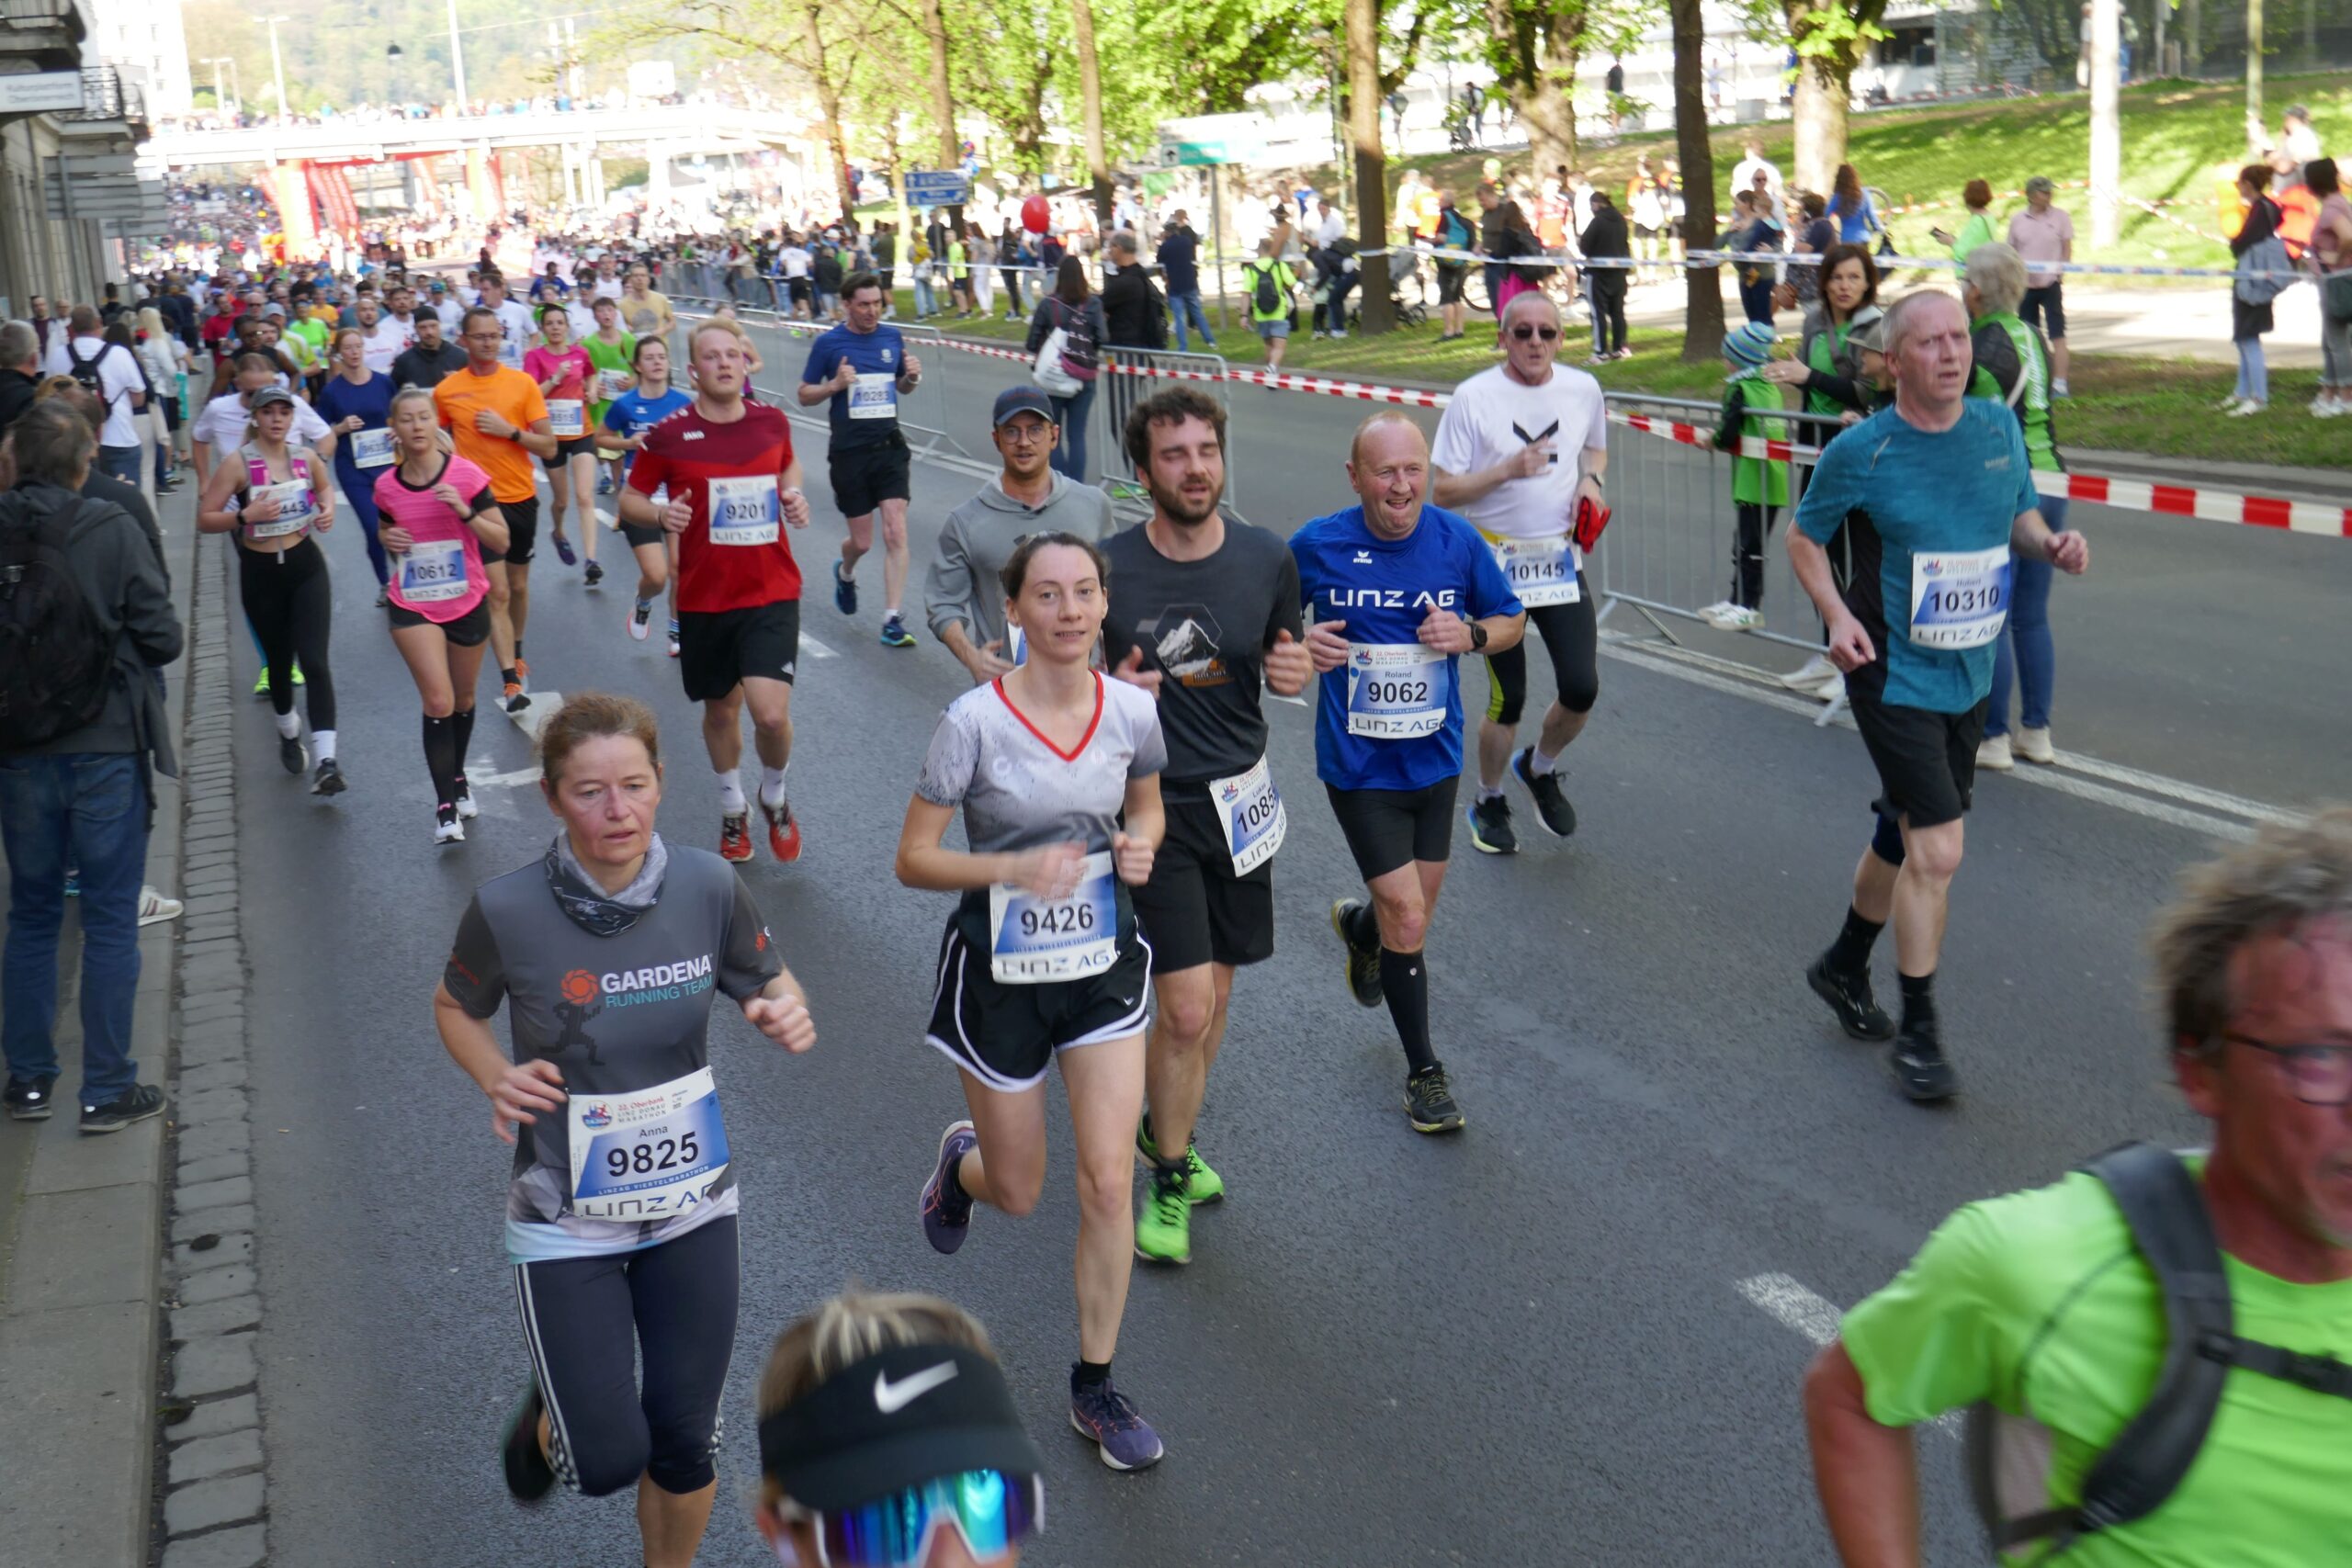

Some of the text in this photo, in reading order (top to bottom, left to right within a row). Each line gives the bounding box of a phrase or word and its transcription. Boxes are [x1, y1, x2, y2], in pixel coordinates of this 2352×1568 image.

[279, 500, 306, 514] 443
[726, 502, 766, 521] 9201
[409, 563, 458, 581] 10612
[1509, 561, 1565, 581] 10145
[1329, 589, 1455, 608] LINZ AG
[1929, 584, 2000, 614] 10310
[1385, 671, 1412, 679] Roland
[1367, 682, 1428, 704] 9062
[1355, 716, 1440, 733] LINZ AG
[1020, 903, 1094, 937] 9426
[600, 954, 712, 993] GARDENA
[1002, 949, 1111, 977] LINZ AG
[605, 975, 713, 1009] RUNNING TEAM
[639, 1125, 669, 1139] Anna
[606, 1131, 699, 1178] 9825
[634, 1165, 710, 1190] VIERTELMARATHON
[585, 1196, 668, 1217] LINZ
